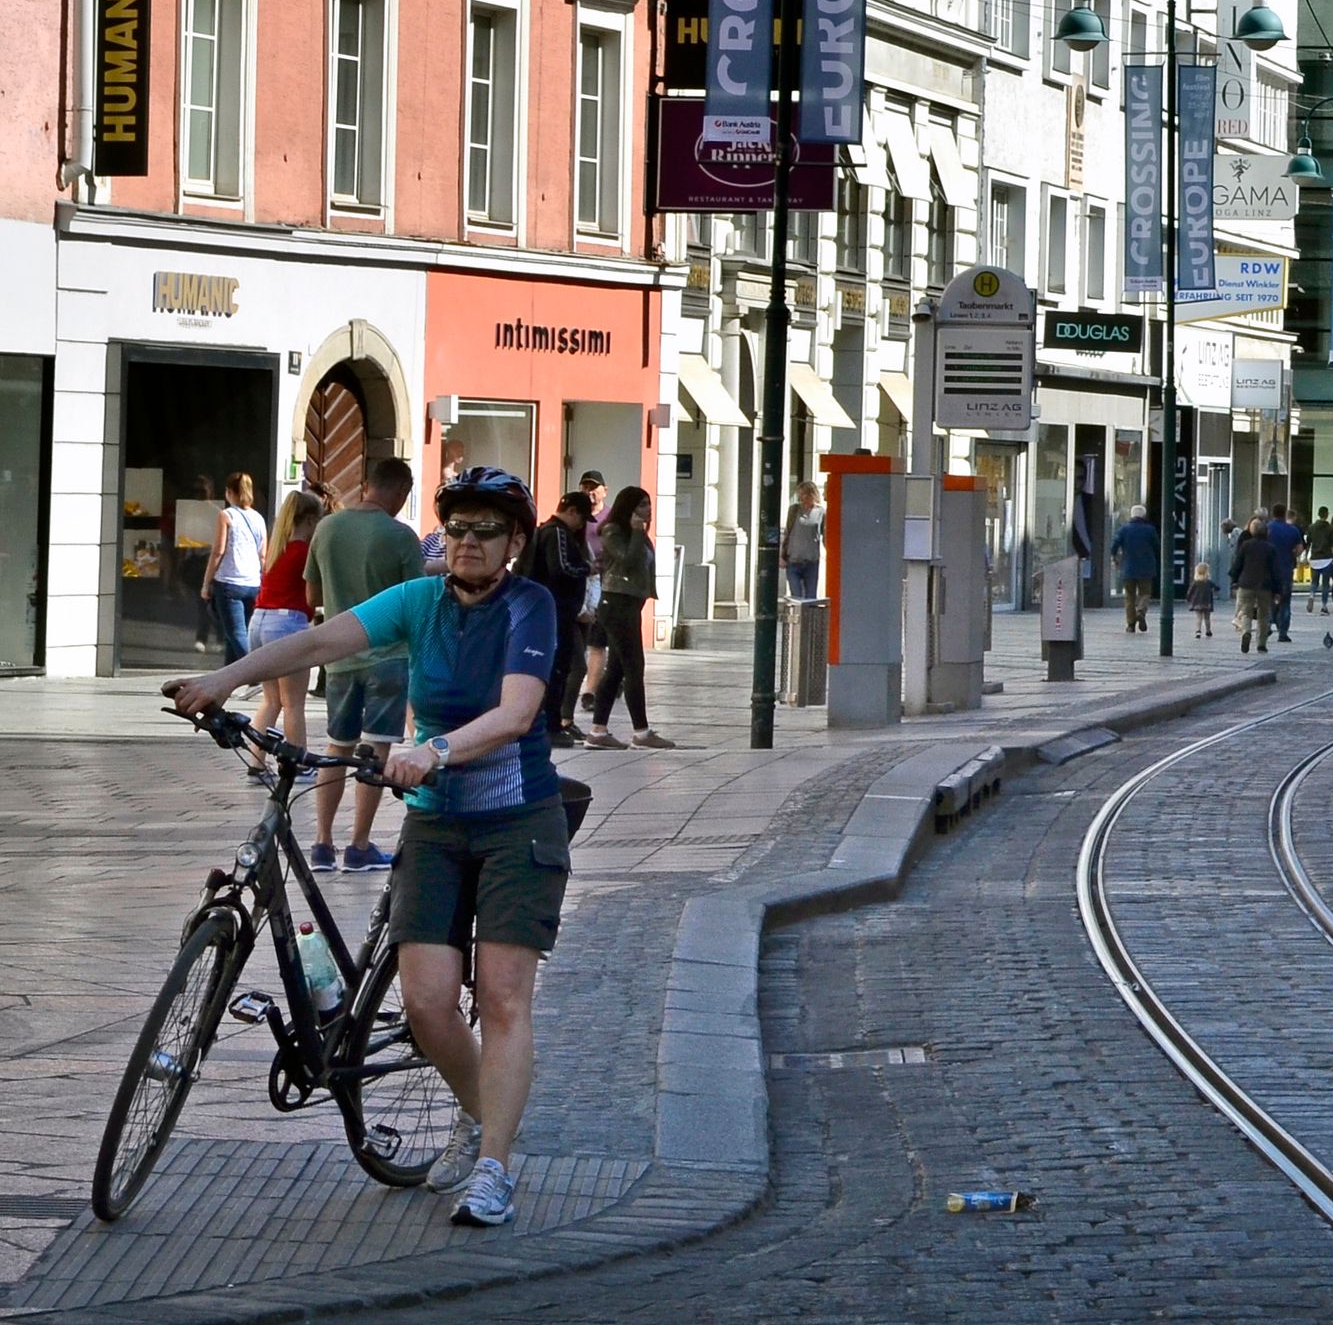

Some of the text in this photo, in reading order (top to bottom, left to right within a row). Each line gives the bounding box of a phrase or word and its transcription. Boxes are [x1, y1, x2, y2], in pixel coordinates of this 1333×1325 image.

[739, 120, 761, 128] Austria
[1217, 118, 1249, 135] RED
[1130, 74, 1157, 266] CROSSING
[1183, 139, 1210, 287] EUROPE
[1215, 209, 1272, 217] OGA LINZ
[980, 277, 993, 292] H
[1218, 279, 1280, 289] Dienst Winkler
[154, 271, 240, 317] HUMANIC
[1235, 293, 1254, 302] SEIT
[1257, 294, 1279, 302] 1970
[958, 301, 1014, 311] Taubenmarkt
[495, 318, 612, 356] intimissimi
[1056, 322, 1131, 342] DOUGLAS
[966, 403, 1022, 412] LINZ AG
